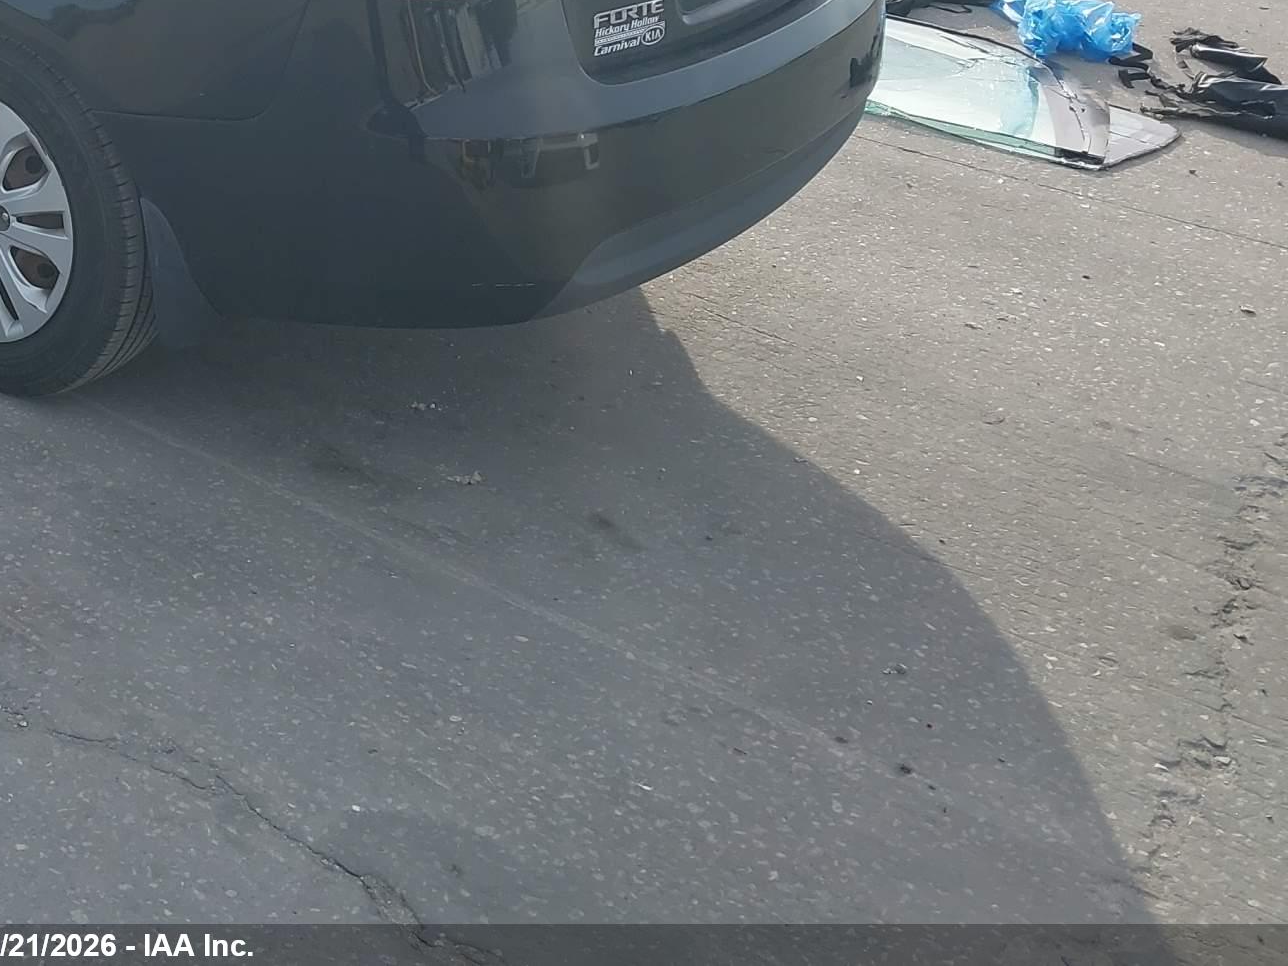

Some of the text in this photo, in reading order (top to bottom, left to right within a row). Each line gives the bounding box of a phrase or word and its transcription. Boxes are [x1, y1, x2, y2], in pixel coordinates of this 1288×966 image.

[594, 23, 630, 39] Hickory
[631, 15, 660, 29] Hollow
[644, 28, 662, 43] KIA
[593, 35, 641, 57] Carnival
